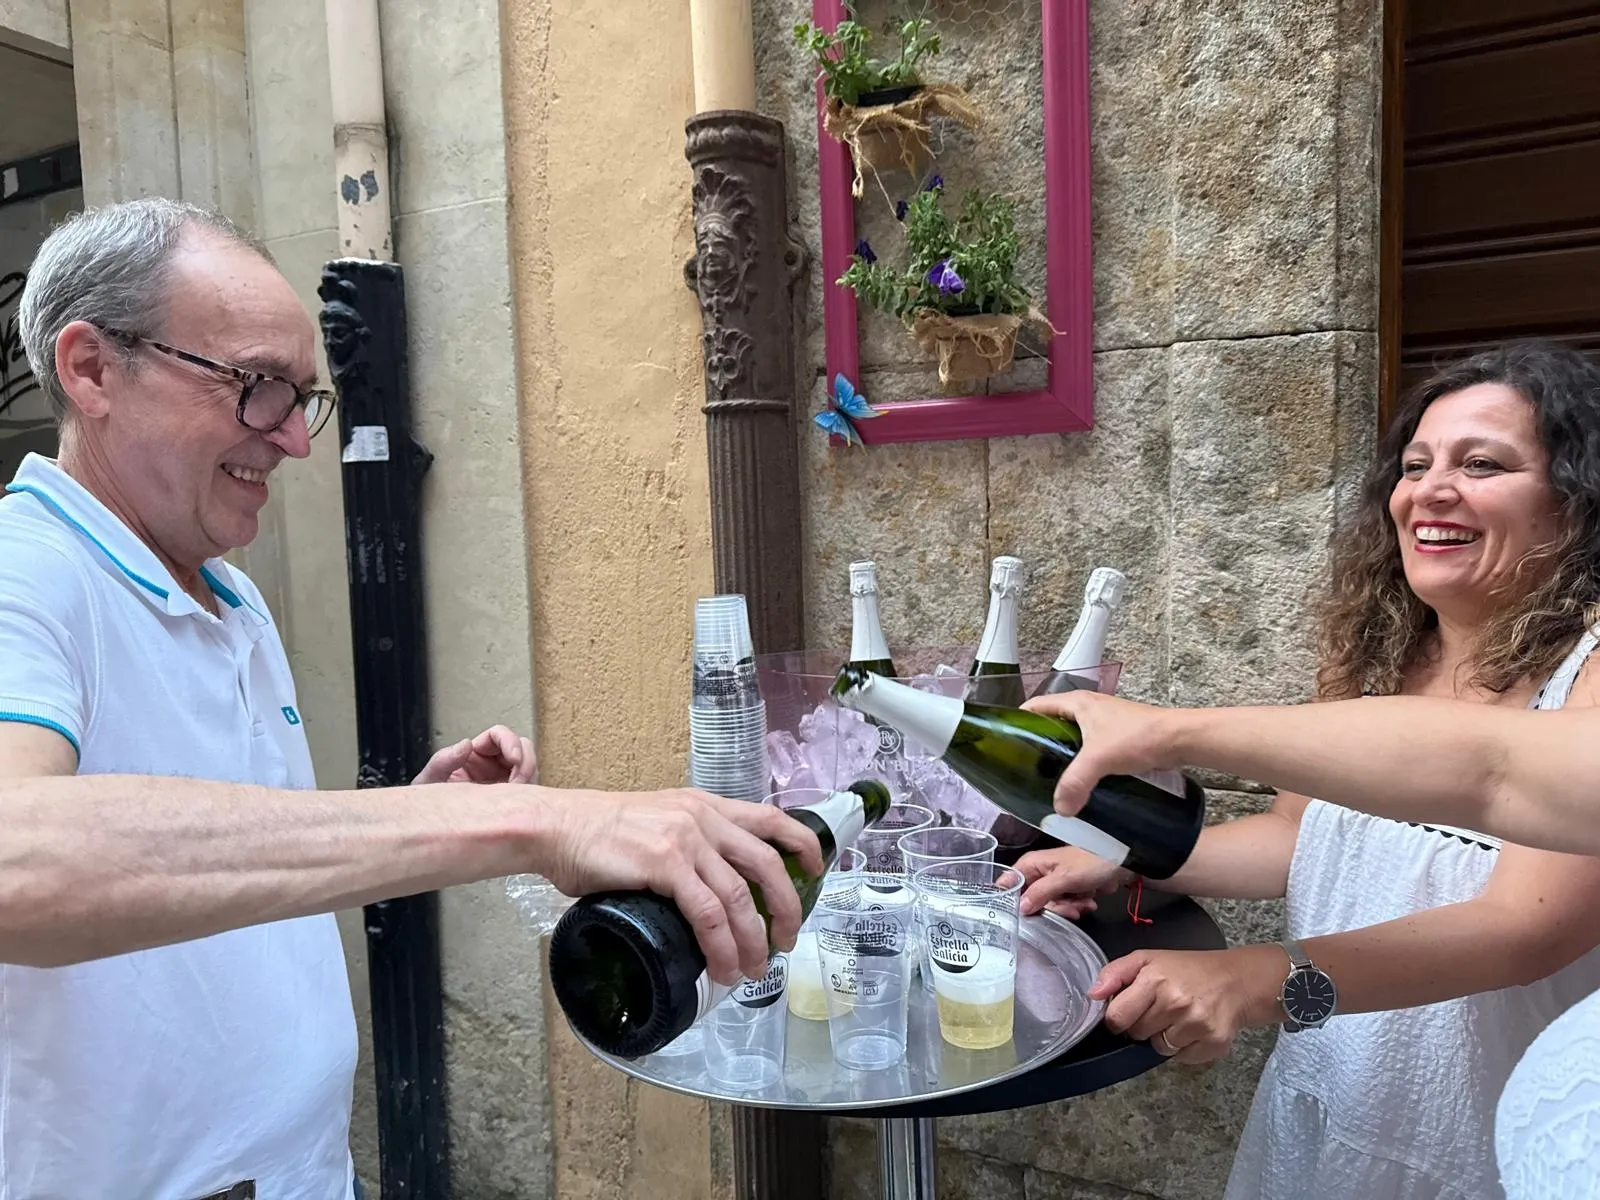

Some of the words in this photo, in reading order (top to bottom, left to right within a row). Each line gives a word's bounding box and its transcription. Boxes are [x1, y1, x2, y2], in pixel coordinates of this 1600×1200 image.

[930, 932, 969, 951] Estrella
[932, 944, 968, 963] Galicia
[743, 965, 784, 985] ella
[743, 979, 782, 998] Galicia
